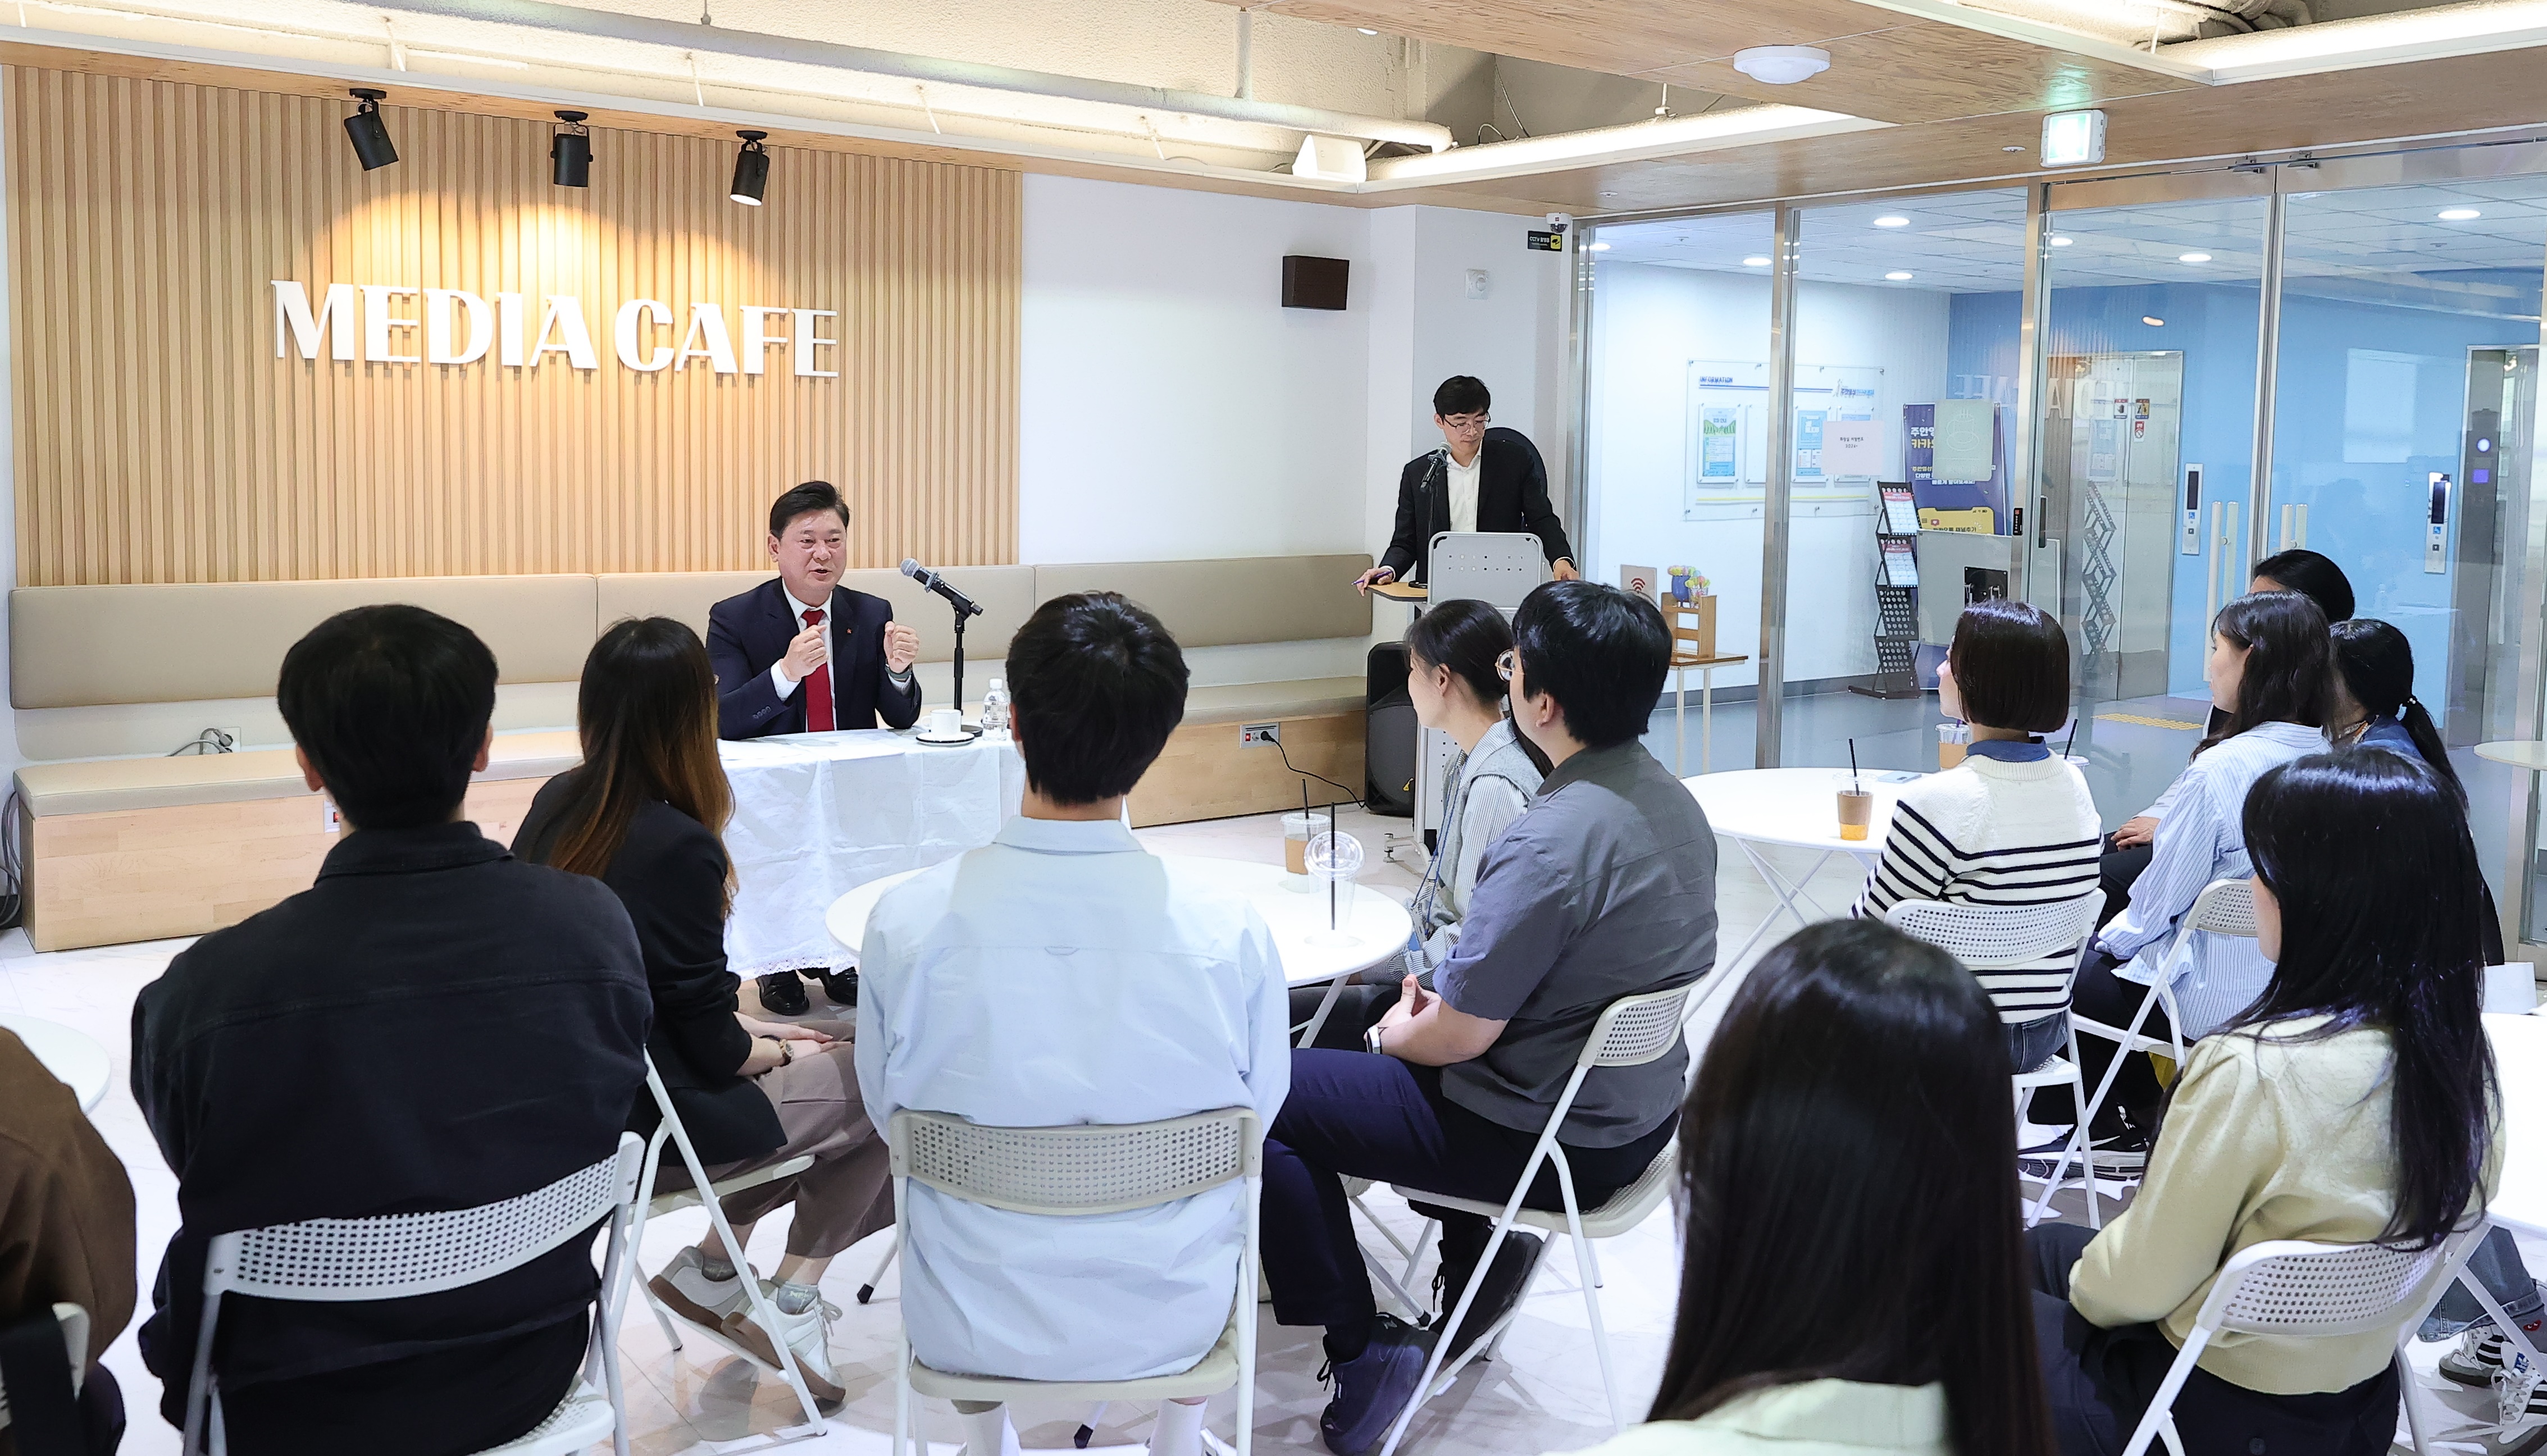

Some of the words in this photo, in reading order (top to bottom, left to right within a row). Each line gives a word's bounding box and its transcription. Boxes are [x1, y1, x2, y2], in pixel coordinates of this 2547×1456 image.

[271, 280, 598, 370] MEDIA
[614, 298, 839, 378] CAFE
[1911, 439, 1934, 449] 카카
